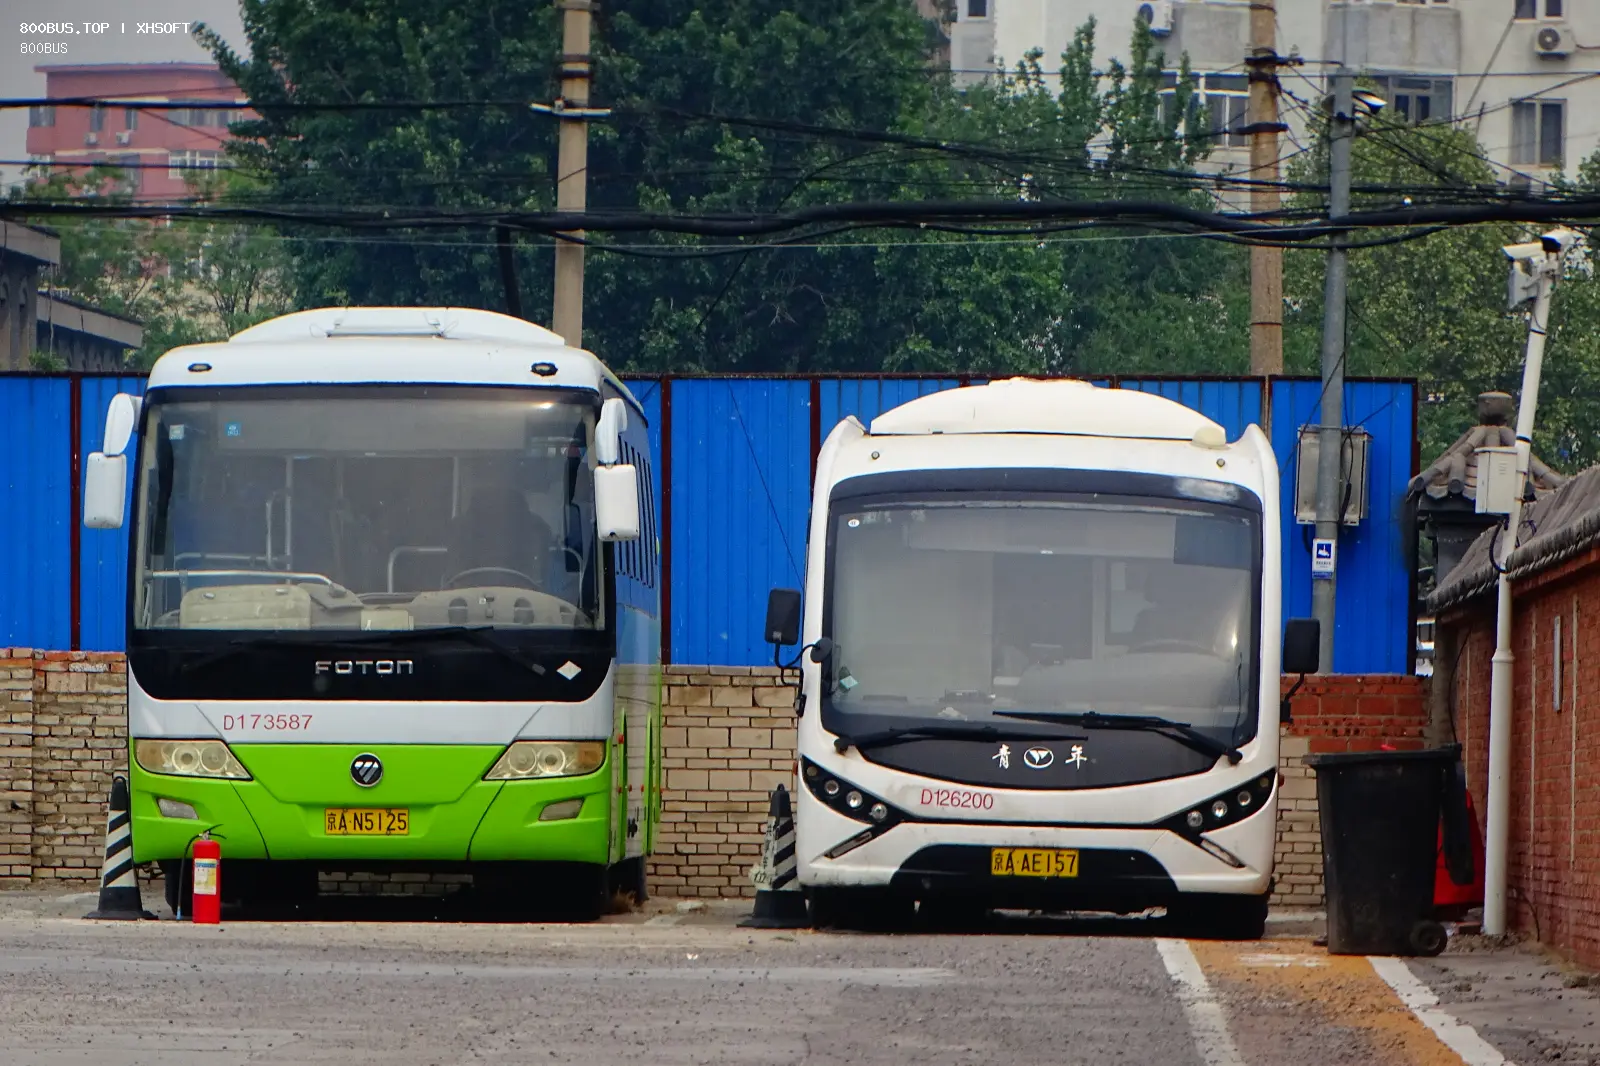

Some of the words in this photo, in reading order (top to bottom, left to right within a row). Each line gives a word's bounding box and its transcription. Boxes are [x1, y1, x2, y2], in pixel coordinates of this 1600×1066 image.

[315, 660, 413, 674] FOTON
[223, 714, 313, 730] D173587
[991, 743, 1011, 769] 青
[1065, 744, 1088, 770] 年
[920, 788, 994, 810] D126200
